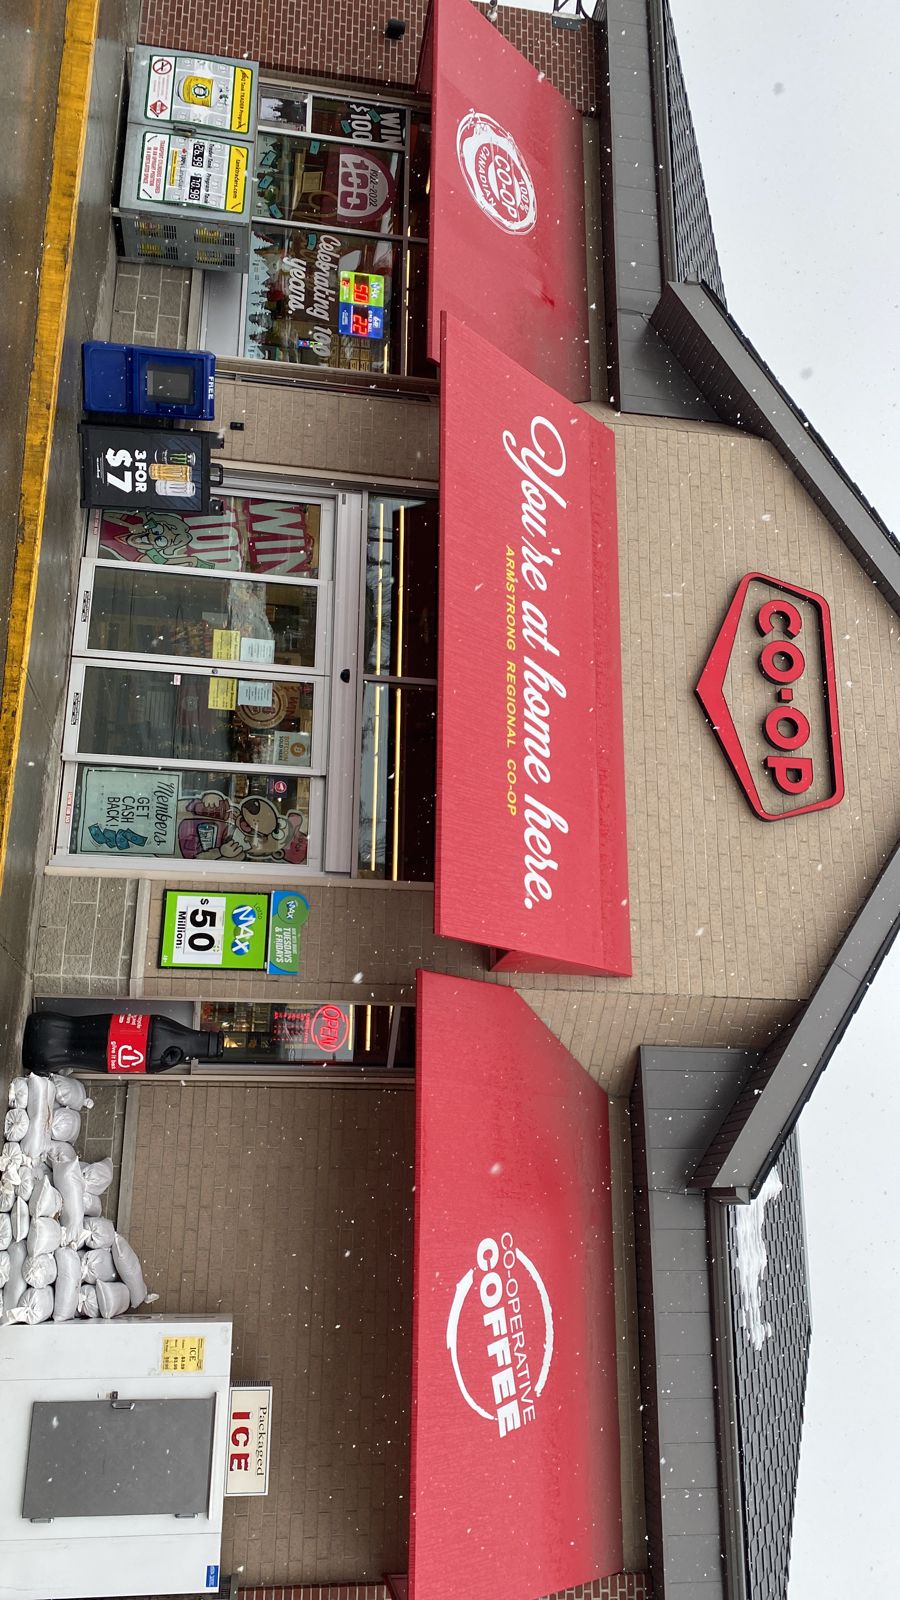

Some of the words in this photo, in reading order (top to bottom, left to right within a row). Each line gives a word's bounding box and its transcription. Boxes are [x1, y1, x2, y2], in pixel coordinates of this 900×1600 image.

[379, 112, 402, 145] WIN
[204, 172, 212, 193] Program
[233, 159, 242, 199] tanktraders.com
[340, 160, 369, 211] 100
[368, 168, 378, 207] 1922-2022
[478, 146, 497, 208] CANADIAN
[494, 155, 518, 219] CO-OP
[518, 178, 529, 213] 100%
[282, 257, 308, 315] years.
[306, 234, 342, 322] Celebrating
[354, 284, 368, 303] 50
[312, 325, 333, 357] 100
[352, 314, 367, 335] 22
[106, 448, 133, 493] $7
[135, 449, 147, 460] 3
[135, 462, 147, 493] FOR
[502, 415, 567, 592] You're
[249, 502, 310, 575] WIN
[506, 545, 516, 651] ARMSTRONG
[522, 600, 560, 657] at
[506, 659, 516, 748] REGIONAL
[756, 600, 813, 795] CO-OP
[523, 655, 567, 785] home
[282, 735, 290, 761] BITCOIN
[121, 796, 136, 823] CASH
[136, 796, 150, 820] GET
[507, 759, 517, 816] CO-OP
[105, 796, 121, 827] BACK!
[153, 781, 175, 846] Members
[524, 793, 569, 910] here.
[176, 911, 187, 945] Million
[188, 908, 217, 952] 50
[274, 934, 284, 963] FRIDAYS
[282, 927, 293, 963] TUESDAYS
[319, 1007, 341, 1048] OPEN
[476, 1237, 521, 1439] COFFEE
[501, 1232, 536, 1425] CO-OPERATIVE
[189, 1347, 197, 1362] ICE
[230, 1411, 251, 1472] ICE
[255, 1405, 268, 1476] Packaged
